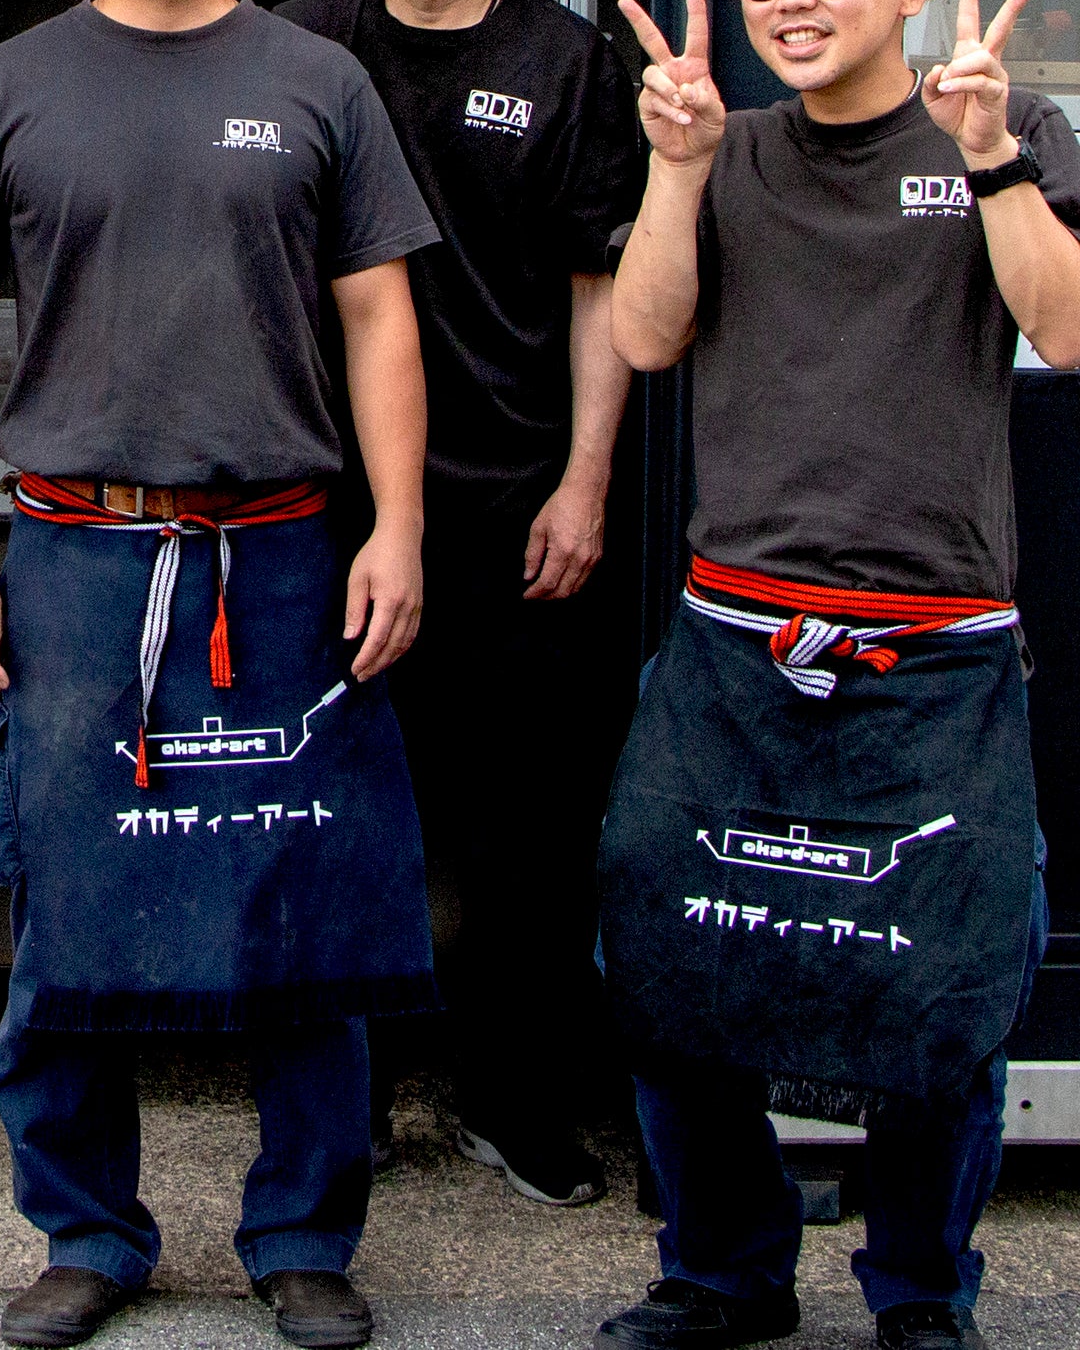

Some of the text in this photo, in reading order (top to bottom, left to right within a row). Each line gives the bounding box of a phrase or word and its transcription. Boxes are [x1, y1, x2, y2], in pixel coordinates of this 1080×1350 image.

[161, 738, 267, 756] oka-d-art
[116, 801, 332, 837] オカディーアート
[741, 840, 849, 868] oka-d-art
[684, 896, 912, 952] オカディーアート
